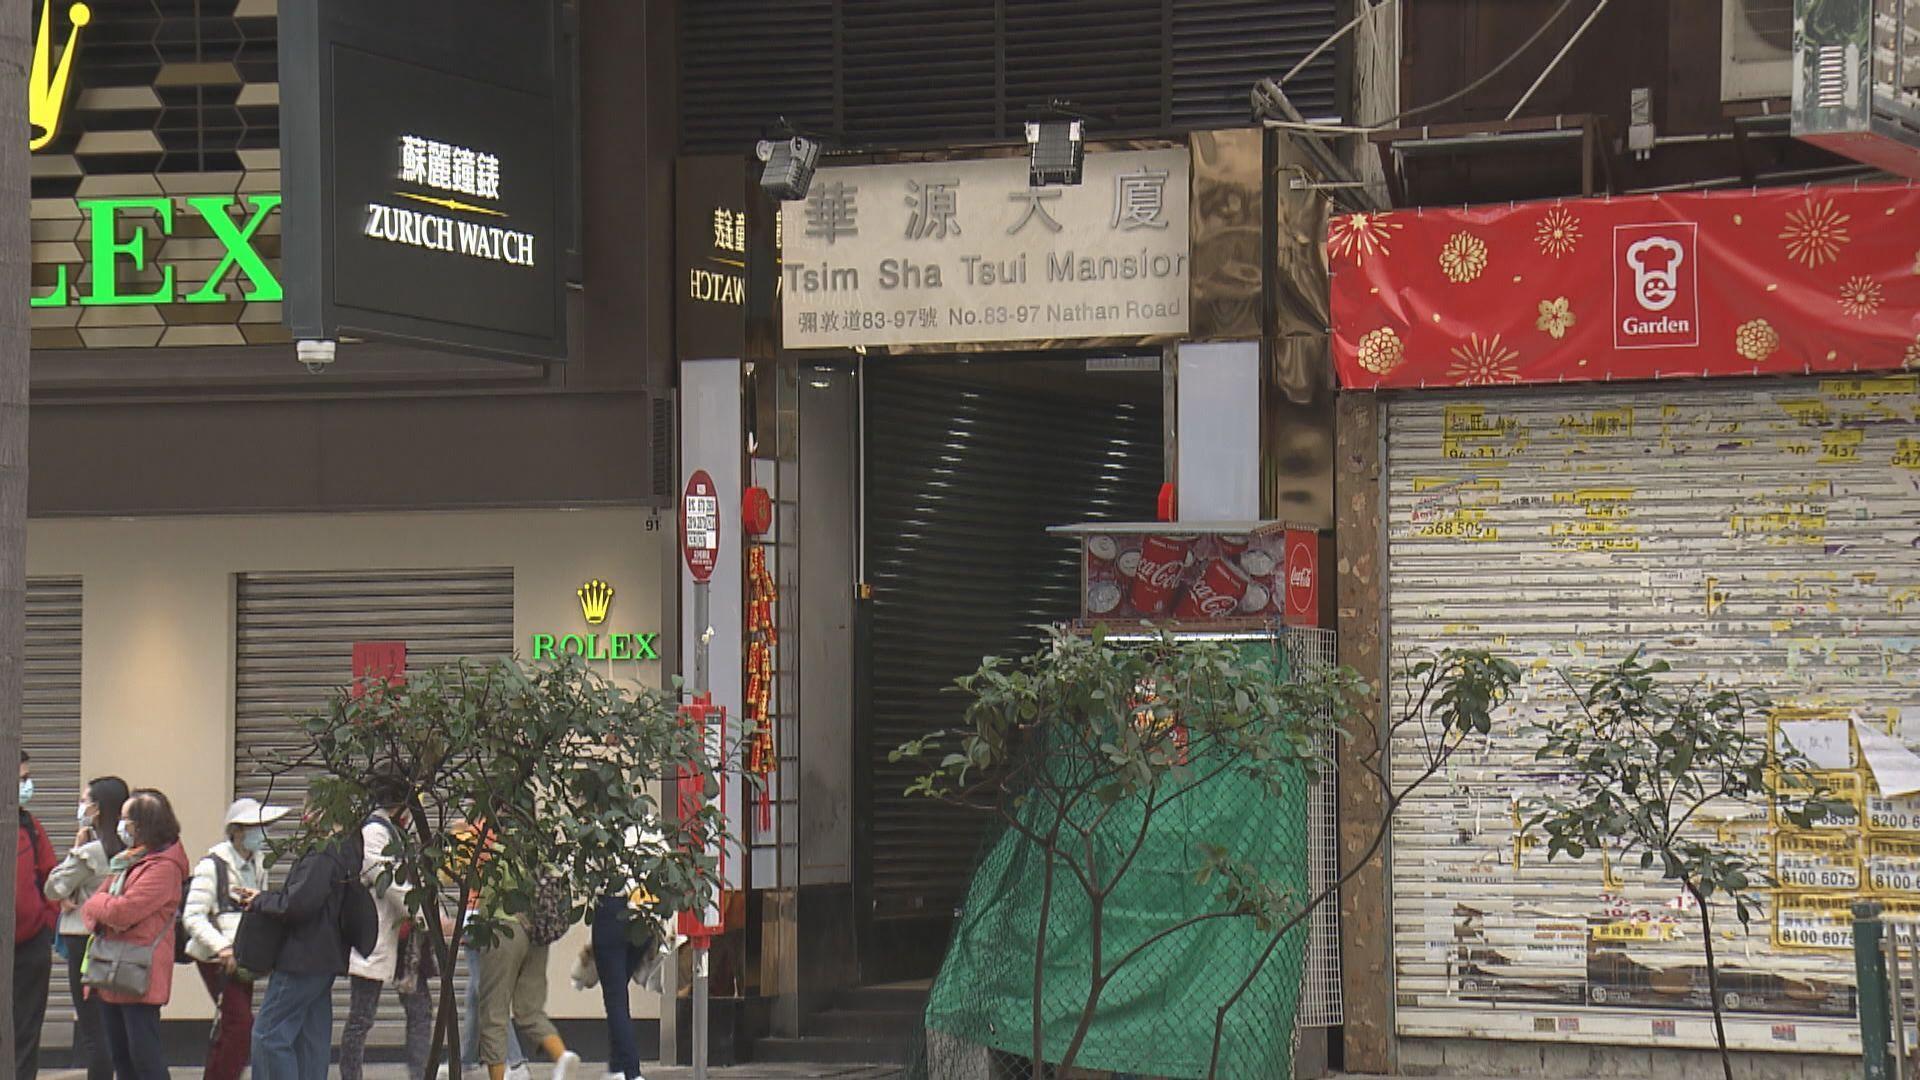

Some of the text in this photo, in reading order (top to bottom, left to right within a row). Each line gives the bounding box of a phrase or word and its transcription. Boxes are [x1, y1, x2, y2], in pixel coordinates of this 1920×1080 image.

[402, 134, 500, 200] 蘇麗鐘錶
[804, 165, 1170, 244] 華源大廈
[367, 203, 535, 266] ZURICH WATCH
[785, 261, 859, 293] Tsim
[879, 257, 943, 290] Sha
[960, 252, 1027, 286] Tsui
[799, 307, 938, 333] 彌敦道83-97號
[1046, 302, 1120, 323] Nathan
[1126, 299, 1181, 319] Road
[1622, 316, 1690, 336] Garden
[645, 519, 661, 531] 91
[532, 633, 658, 660] ROLEX
